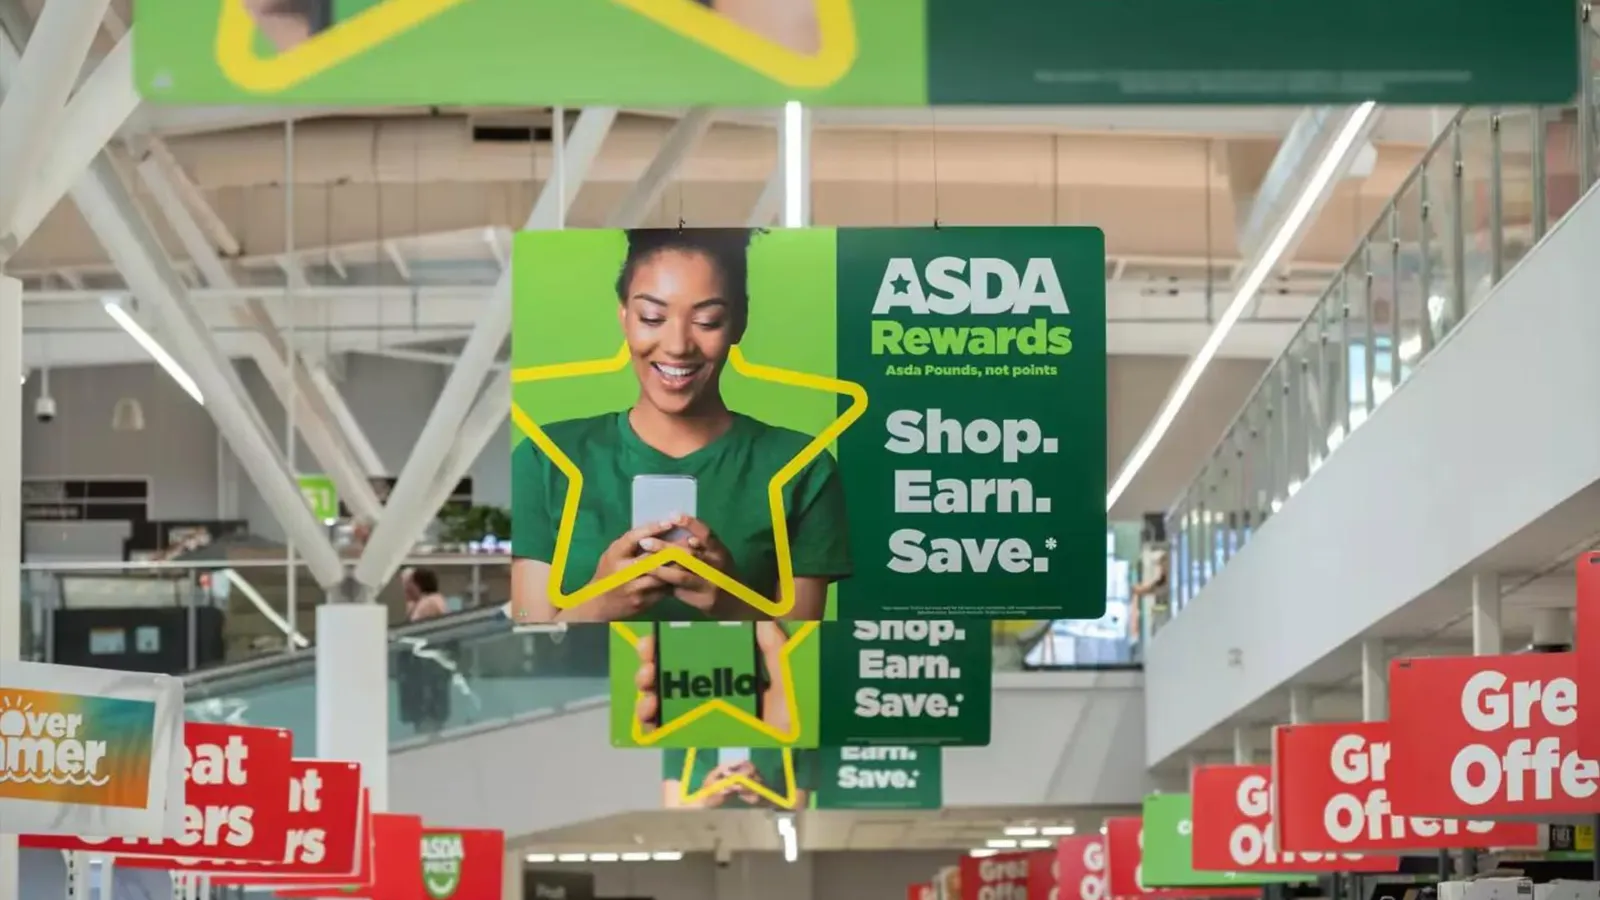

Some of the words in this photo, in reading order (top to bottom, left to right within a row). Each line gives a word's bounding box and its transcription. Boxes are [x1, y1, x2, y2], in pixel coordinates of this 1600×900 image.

[871, 256, 1071, 316] ASDA
[871, 318, 1073, 355] Rewards
[885, 364, 922, 376] Asda
[925, 364, 982, 378] Pounds,
[985, 365, 1009, 376] not
[1012, 364, 1058, 378] points
[884, 408, 1058, 463] Shop.
[894, 469, 1051, 514] Earn.
[859, 649, 961, 679] Earn.
